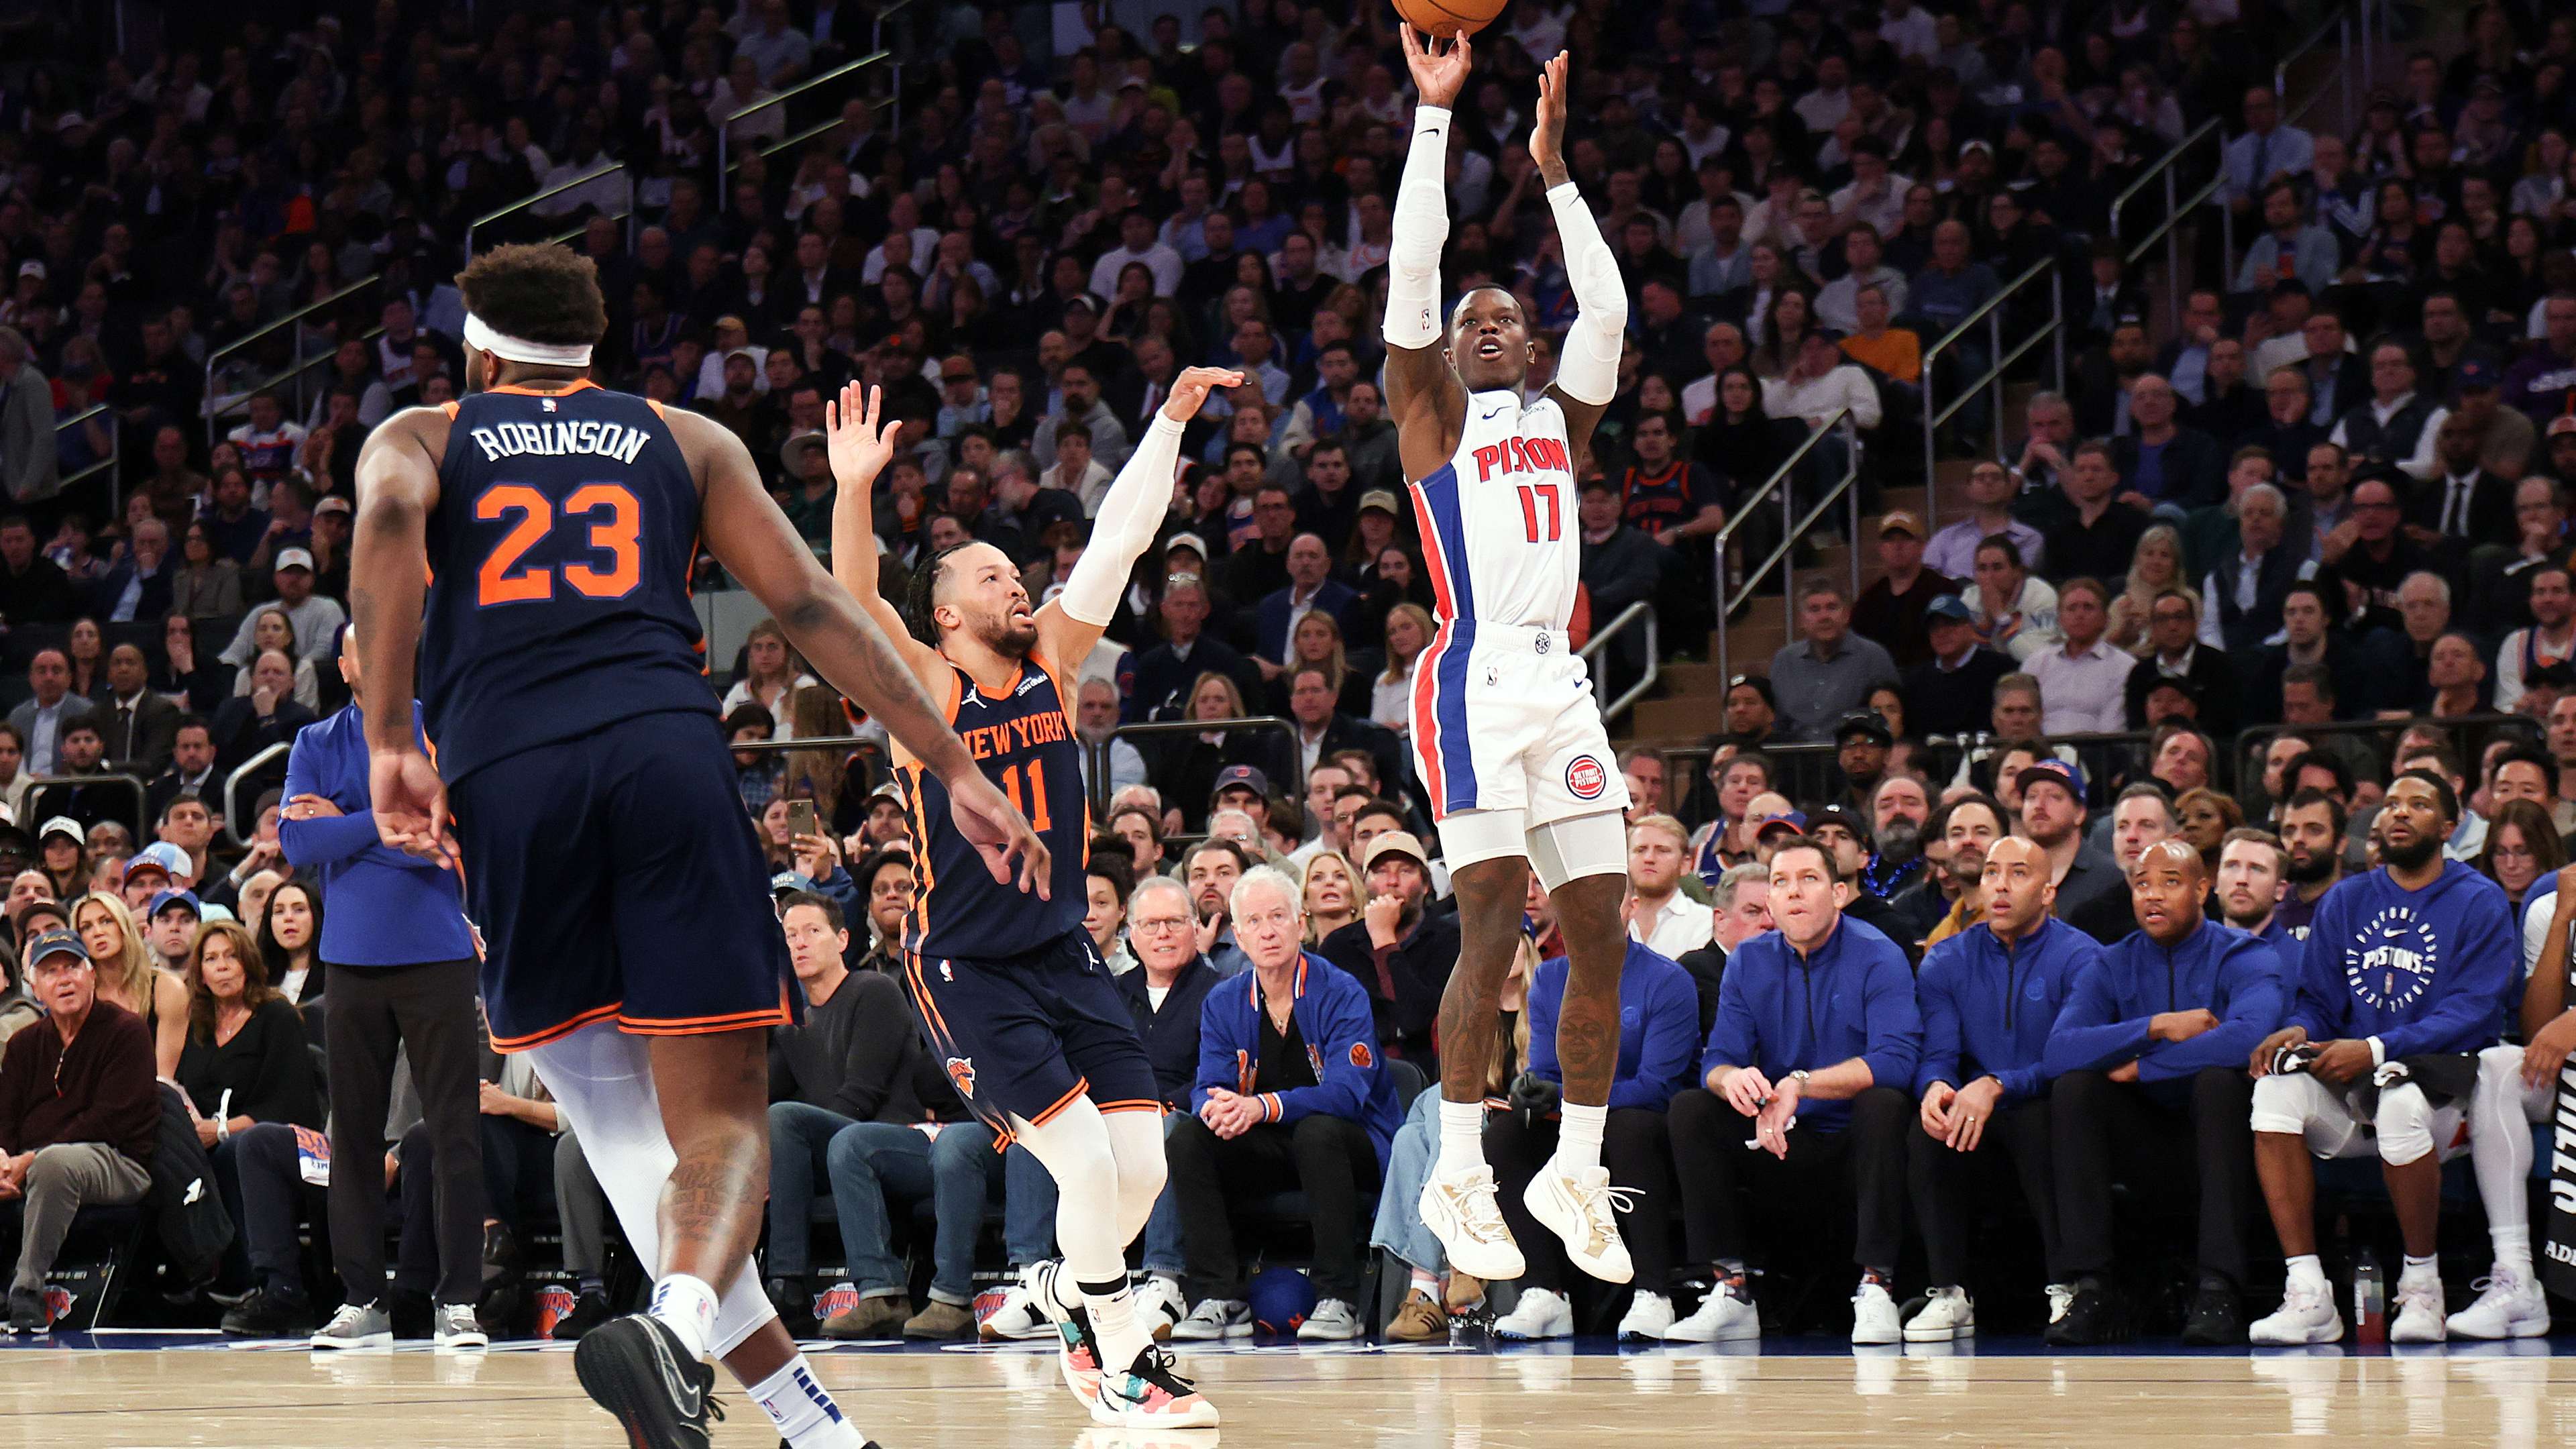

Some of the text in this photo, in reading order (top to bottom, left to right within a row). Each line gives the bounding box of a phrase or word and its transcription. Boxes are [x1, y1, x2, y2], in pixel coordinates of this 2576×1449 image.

[470, 420, 651, 465] ROBINSON
[1472, 436, 1570, 483] PISON
[1517, 484, 1561, 543] 17
[474, 482, 642, 607] 23
[1010, 710, 1067, 749] YORK
[1002, 758, 1053, 833] 11
[1572, 767, 1598, 779] DETROIT
[1575, 775, 1601, 788] PISTONS
[2361, 945, 2424, 974] PISTONS
